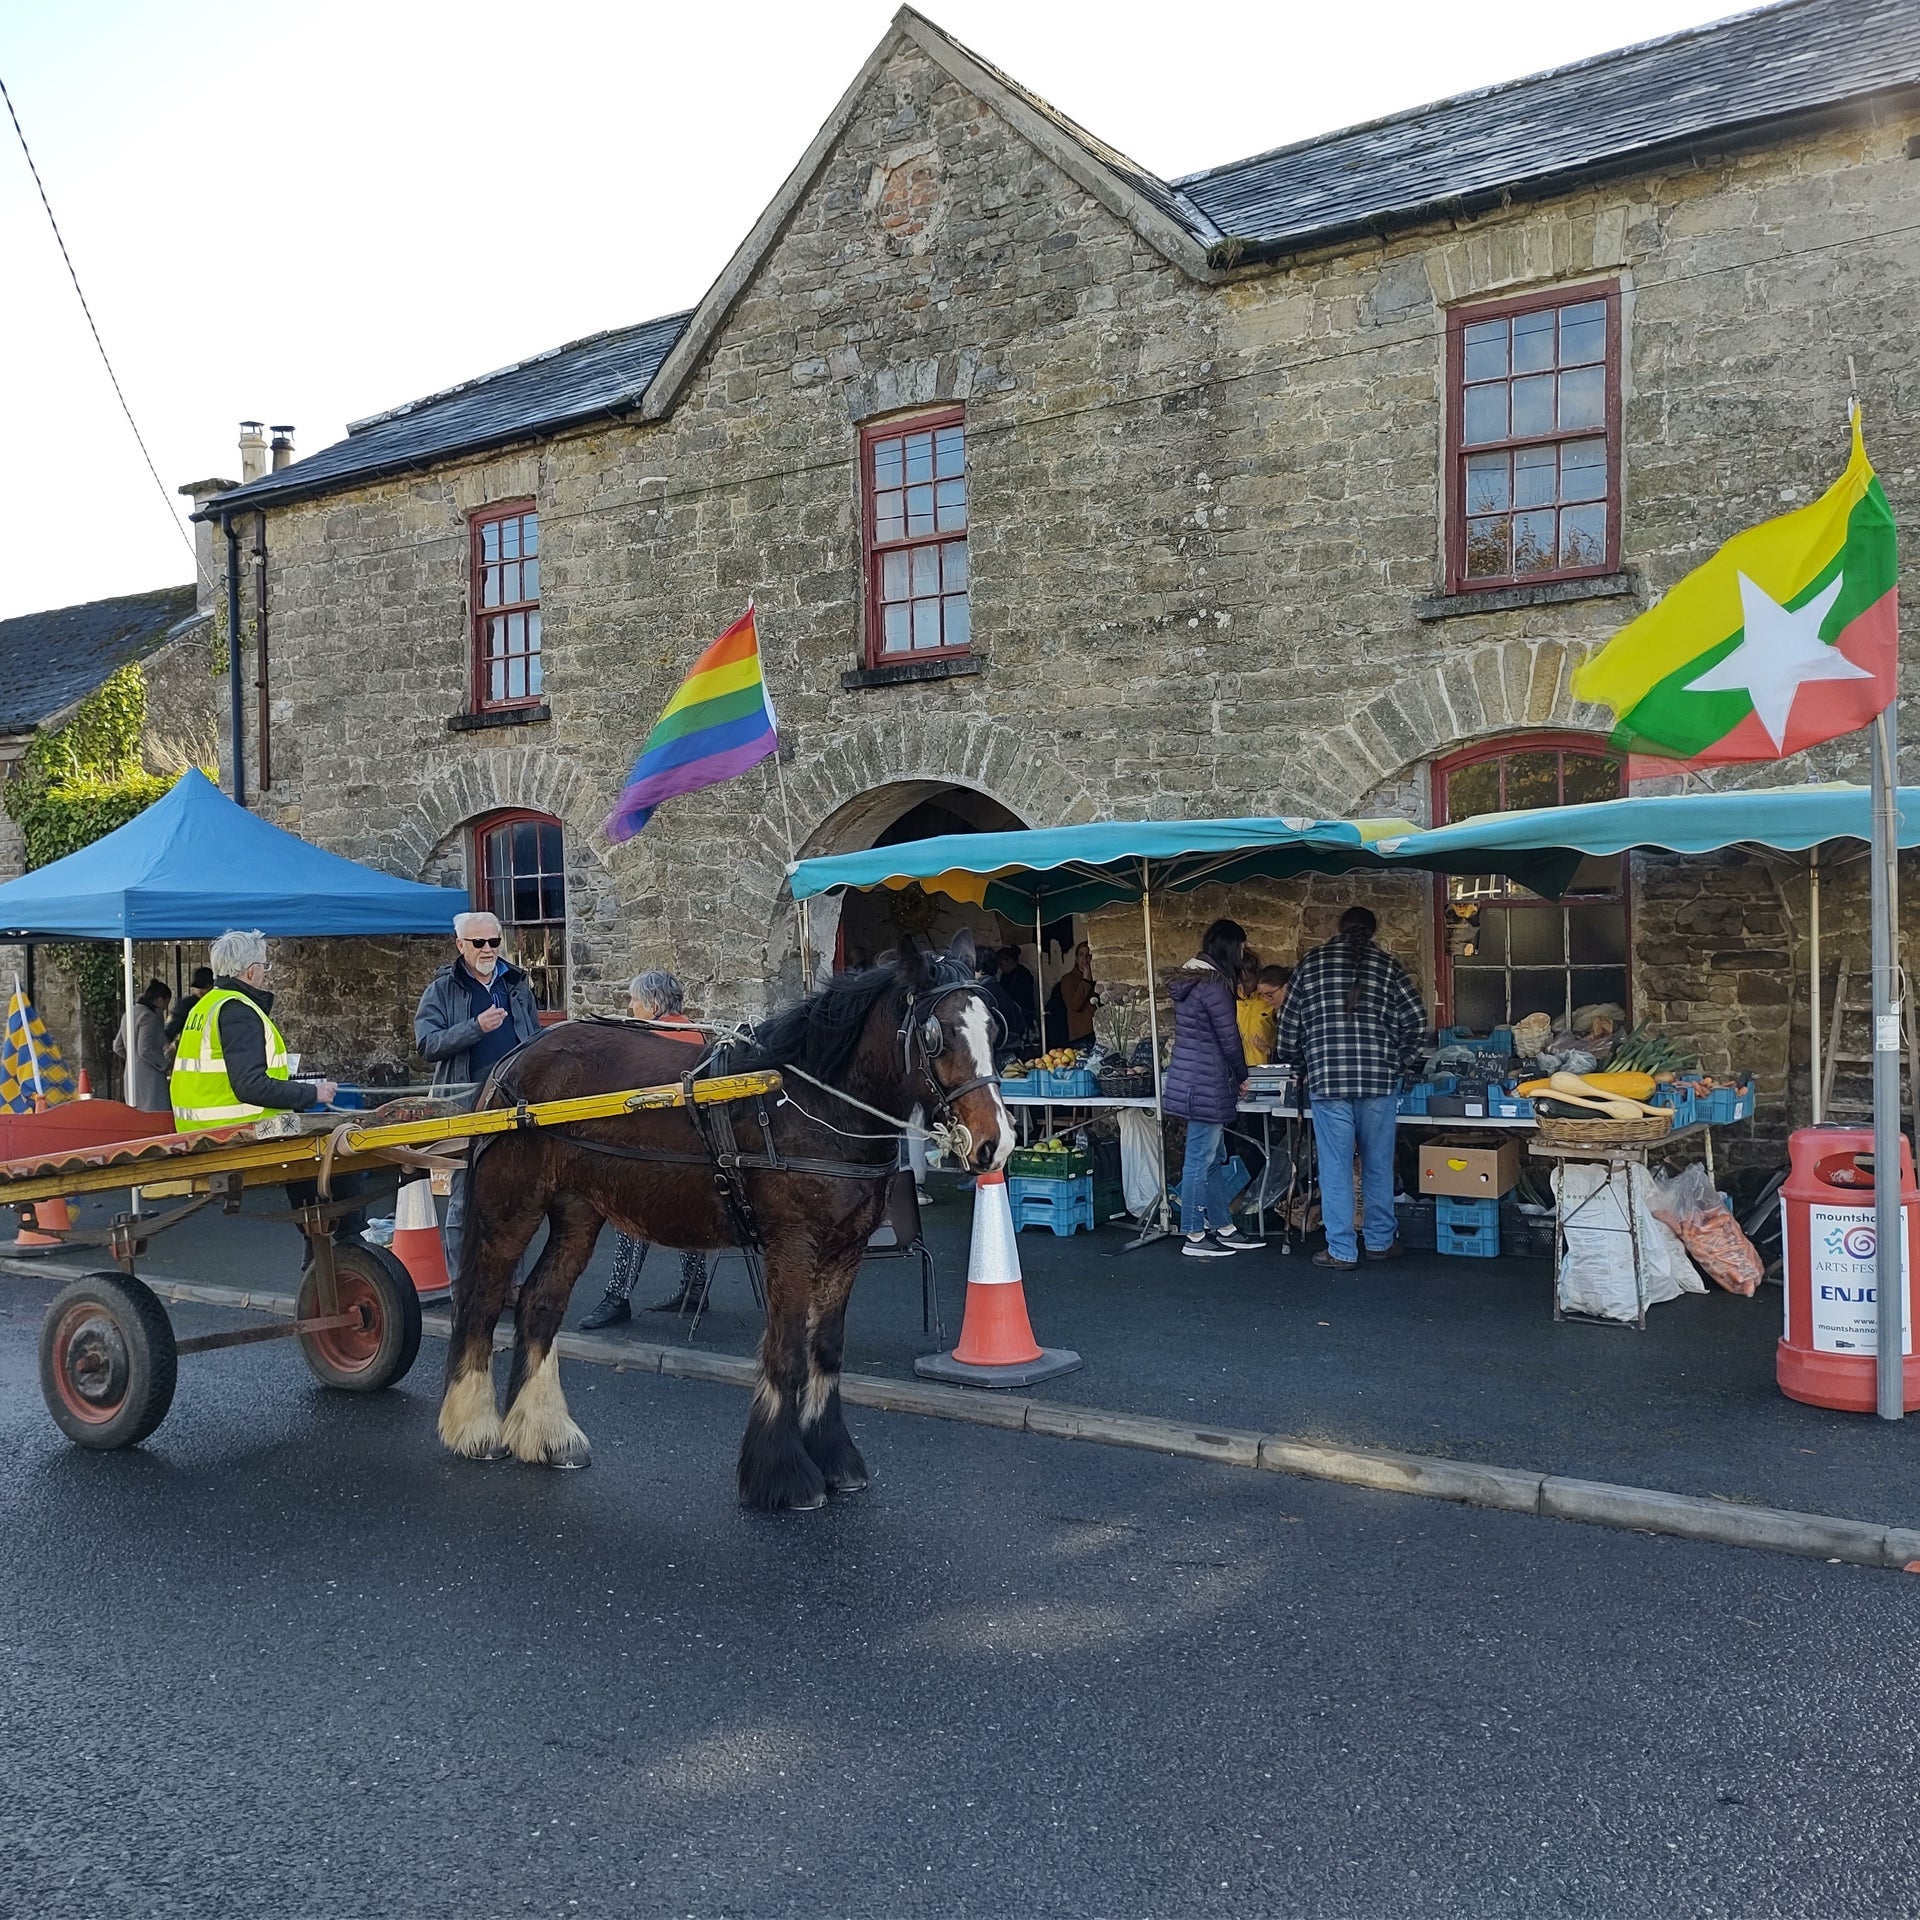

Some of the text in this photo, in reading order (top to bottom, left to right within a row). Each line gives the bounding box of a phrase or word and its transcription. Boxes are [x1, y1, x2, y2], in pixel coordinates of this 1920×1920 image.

[1816, 1262, 1906, 1273] ARTS FESL
[1821, 1286, 1877, 1302] ENJO
